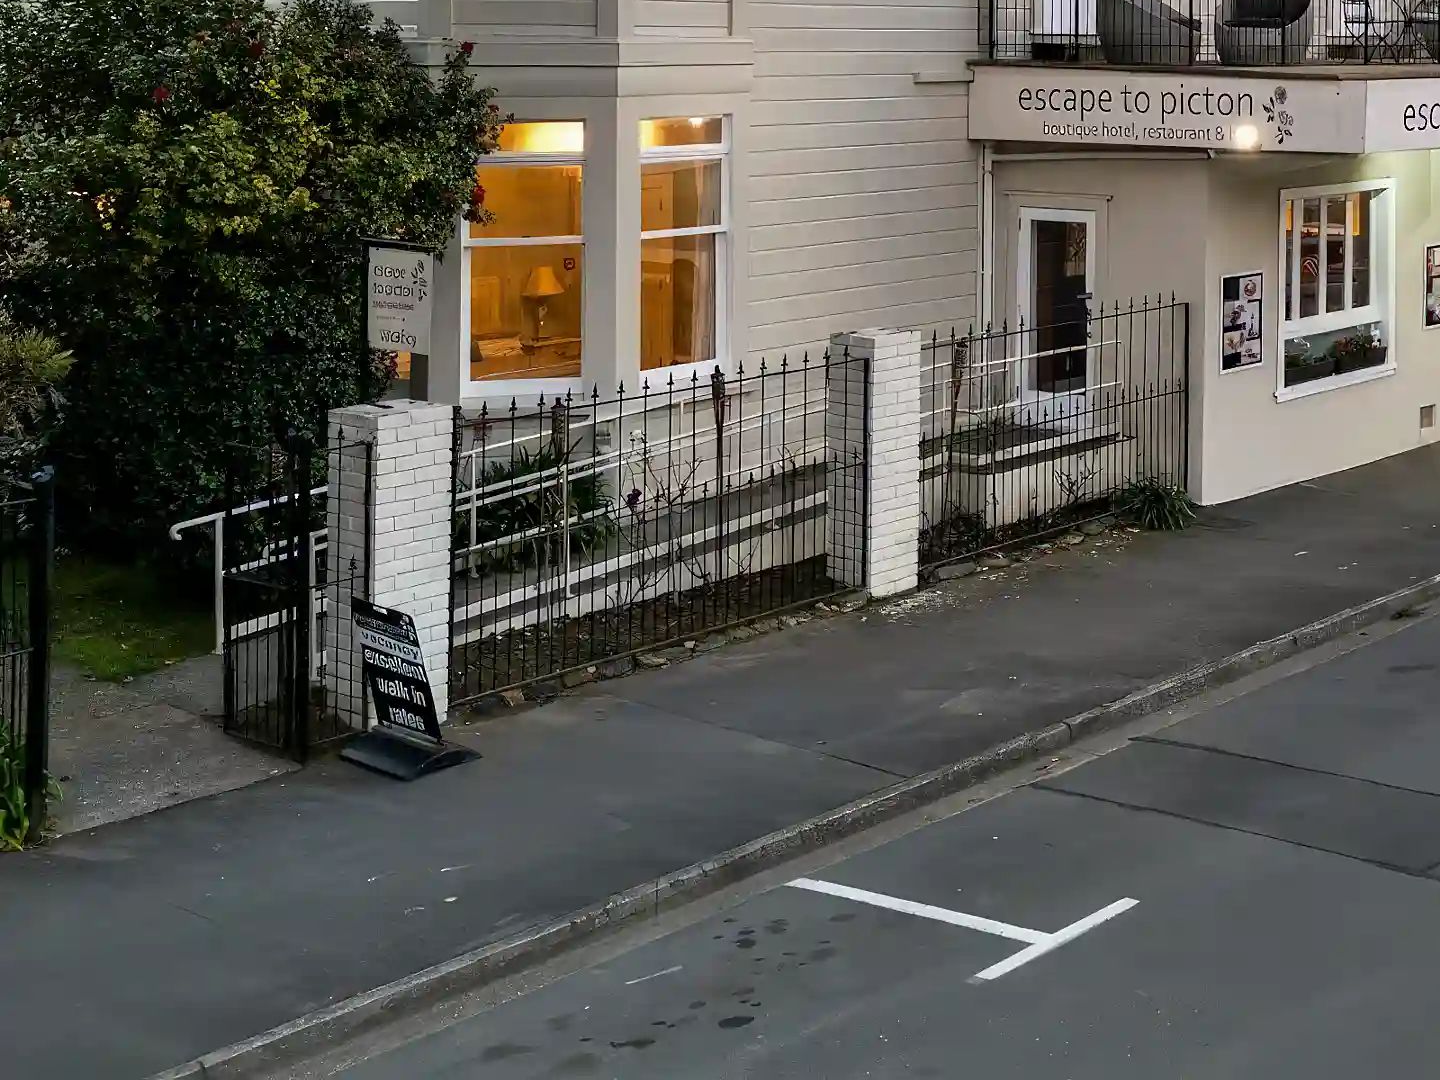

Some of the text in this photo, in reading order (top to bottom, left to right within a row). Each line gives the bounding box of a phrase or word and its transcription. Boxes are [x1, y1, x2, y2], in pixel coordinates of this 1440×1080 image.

[1018, 84, 1254, 125] escape to picton
[1043, 120, 1098, 140] boutique
[1102, 122, 1139, 141] hotel,
[1143, 126, 1211, 142] restaurant
[1215, 126, 1225, 141] &
